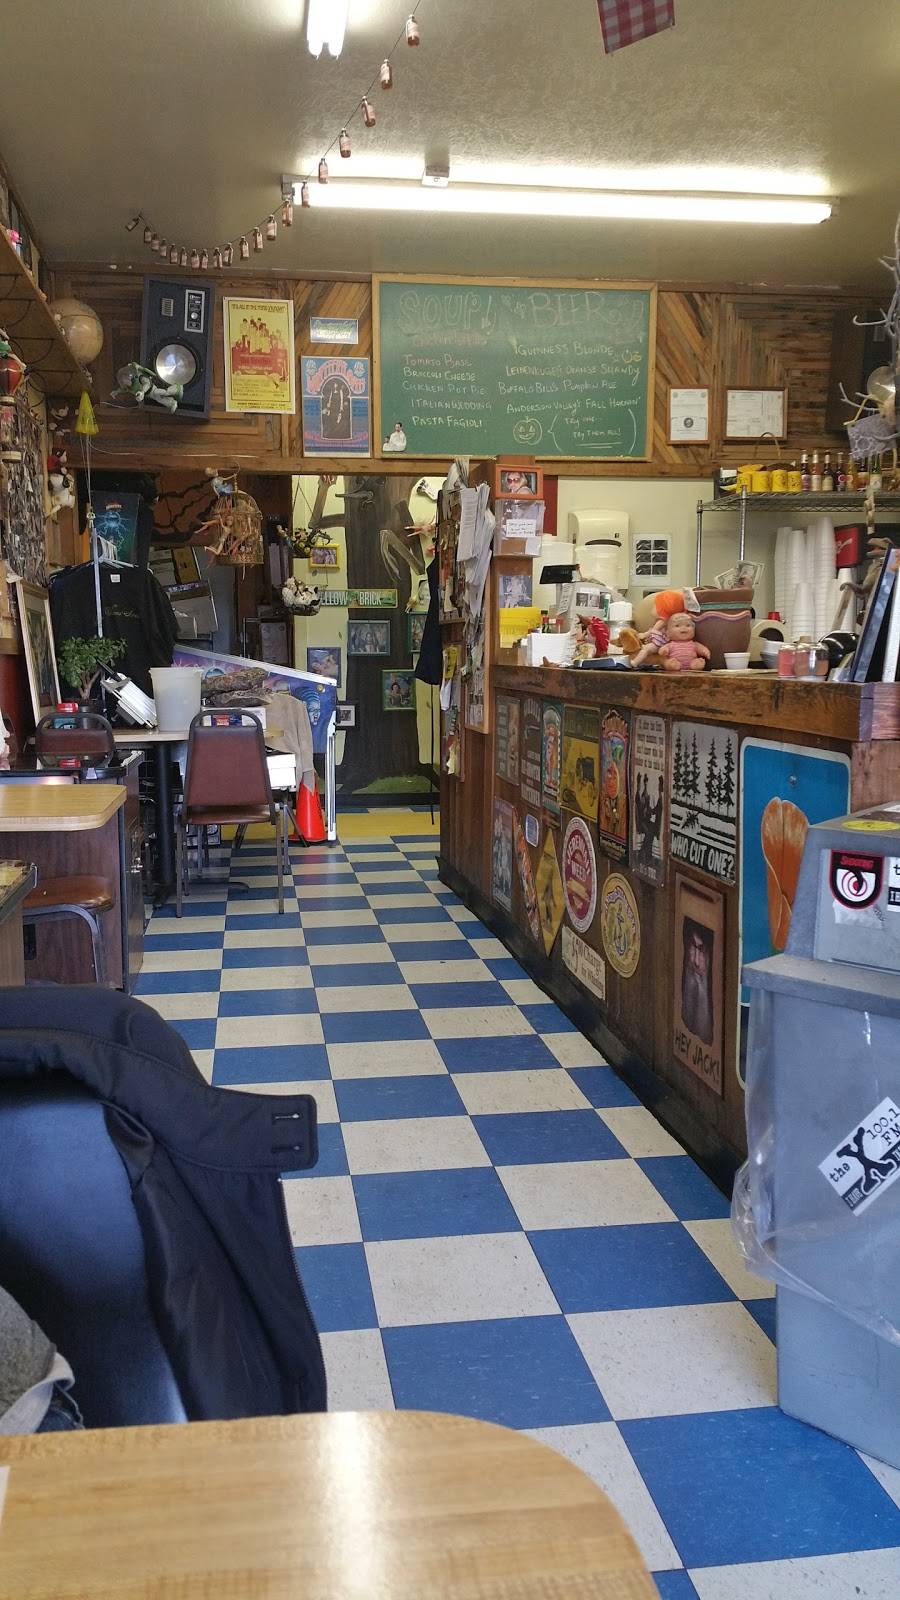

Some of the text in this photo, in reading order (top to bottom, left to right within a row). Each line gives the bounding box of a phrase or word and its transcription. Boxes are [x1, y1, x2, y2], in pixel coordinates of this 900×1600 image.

[359, 591, 381, 606] BRICK
[671, 832, 734, 878] WHO CUT ONE?
[674, 1028, 692, 1058] HEY
[828, 1163, 851, 1183] the
